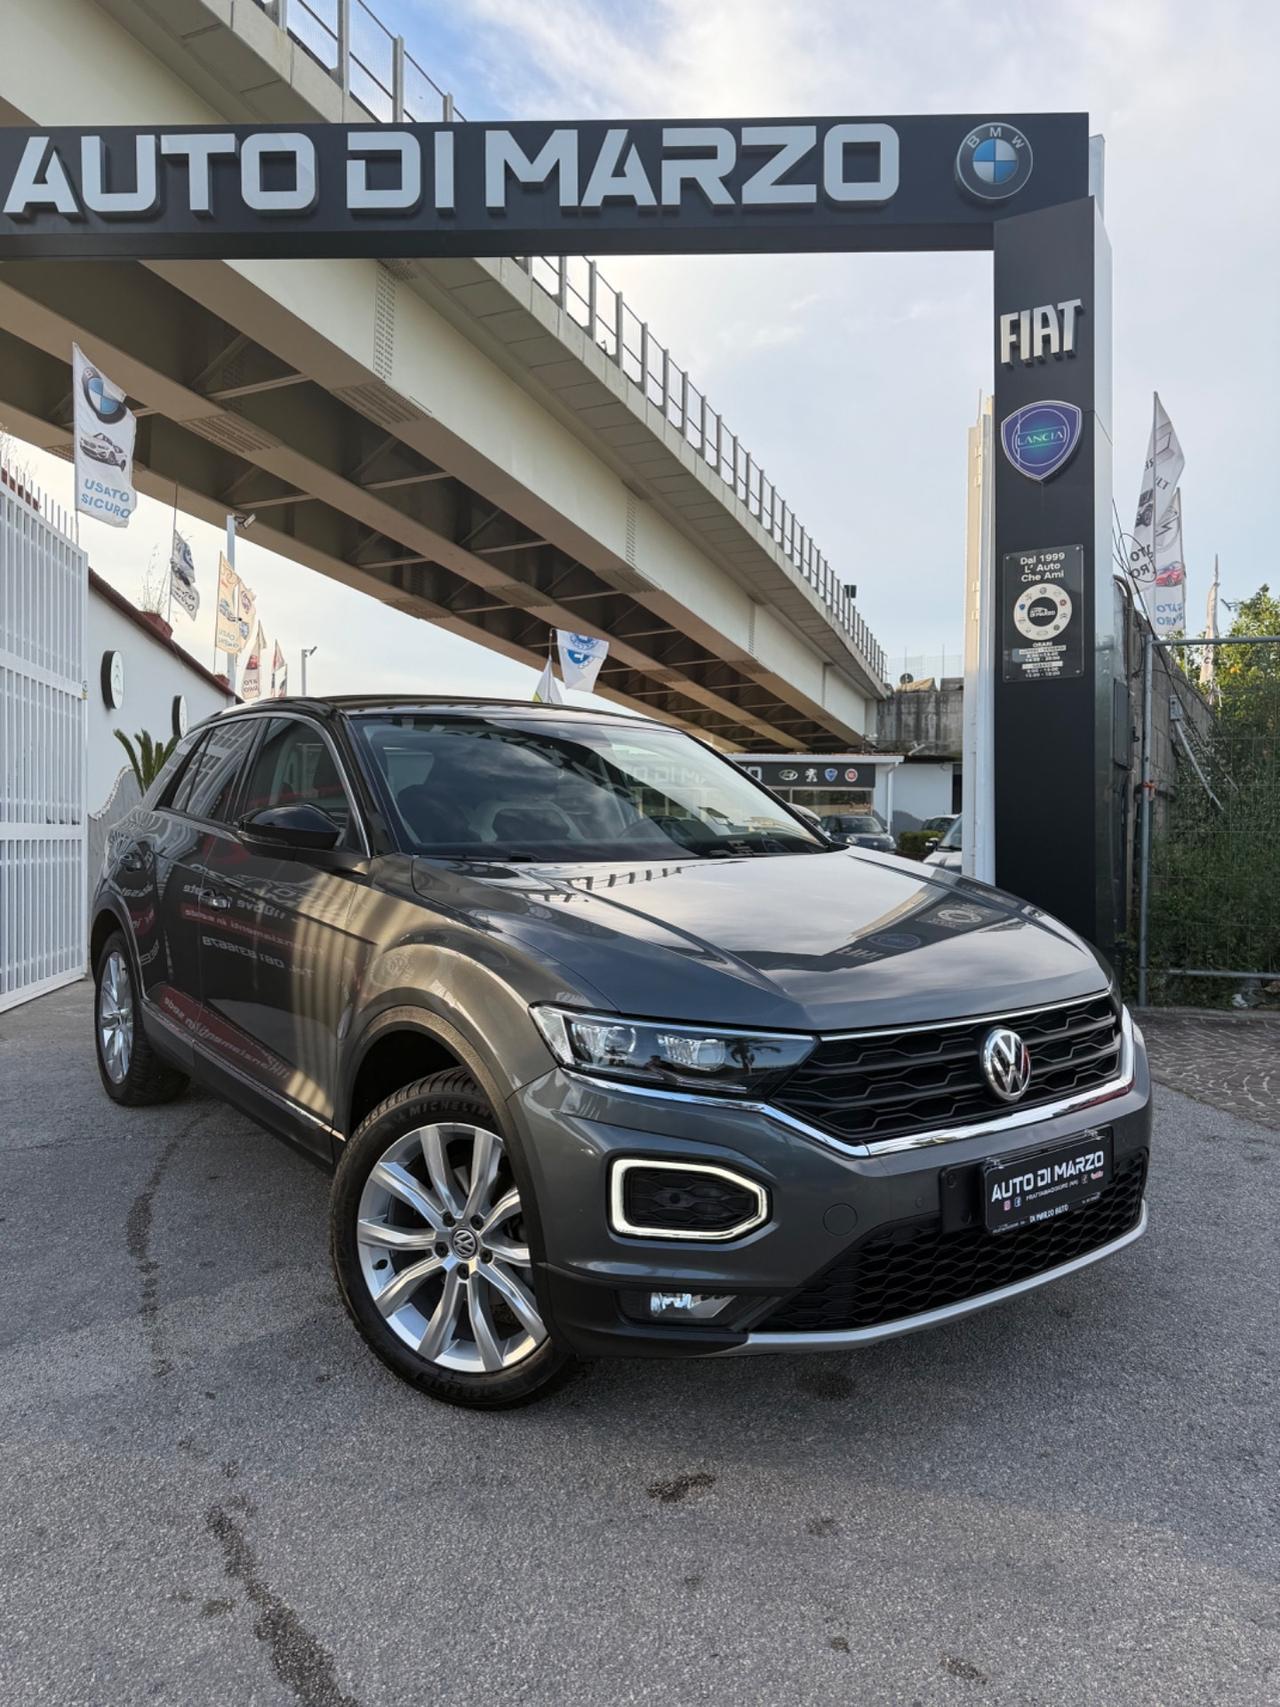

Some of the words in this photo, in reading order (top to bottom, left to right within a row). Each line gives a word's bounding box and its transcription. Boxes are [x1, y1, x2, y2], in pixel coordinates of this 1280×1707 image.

[966, 126, 1025, 149] BMW
[3, 132, 317, 214] AUTO
[346, 130, 455, 210] DI
[485, 123, 900, 209] MARZO
[1000, 299, 1082, 365] FIAT
[1017, 430, 1064, 447] LANCIA
[84, 478, 130, 502] USATO
[81, 493, 132, 519] SICURO
[1020, 555, 1036, 565] Dal
[1040, 552, 1066, 562] 1999
[1036, 563, 1061, 572] Auto
[1021, 573, 1042, 583] Che
[1043, 570, 1065, 580] Ami
[991, 1172, 1034, 1202] AUTO
[1037, 1167, 1051, 1187] DI
[1054, 1151, 1104, 1181] MARZO
